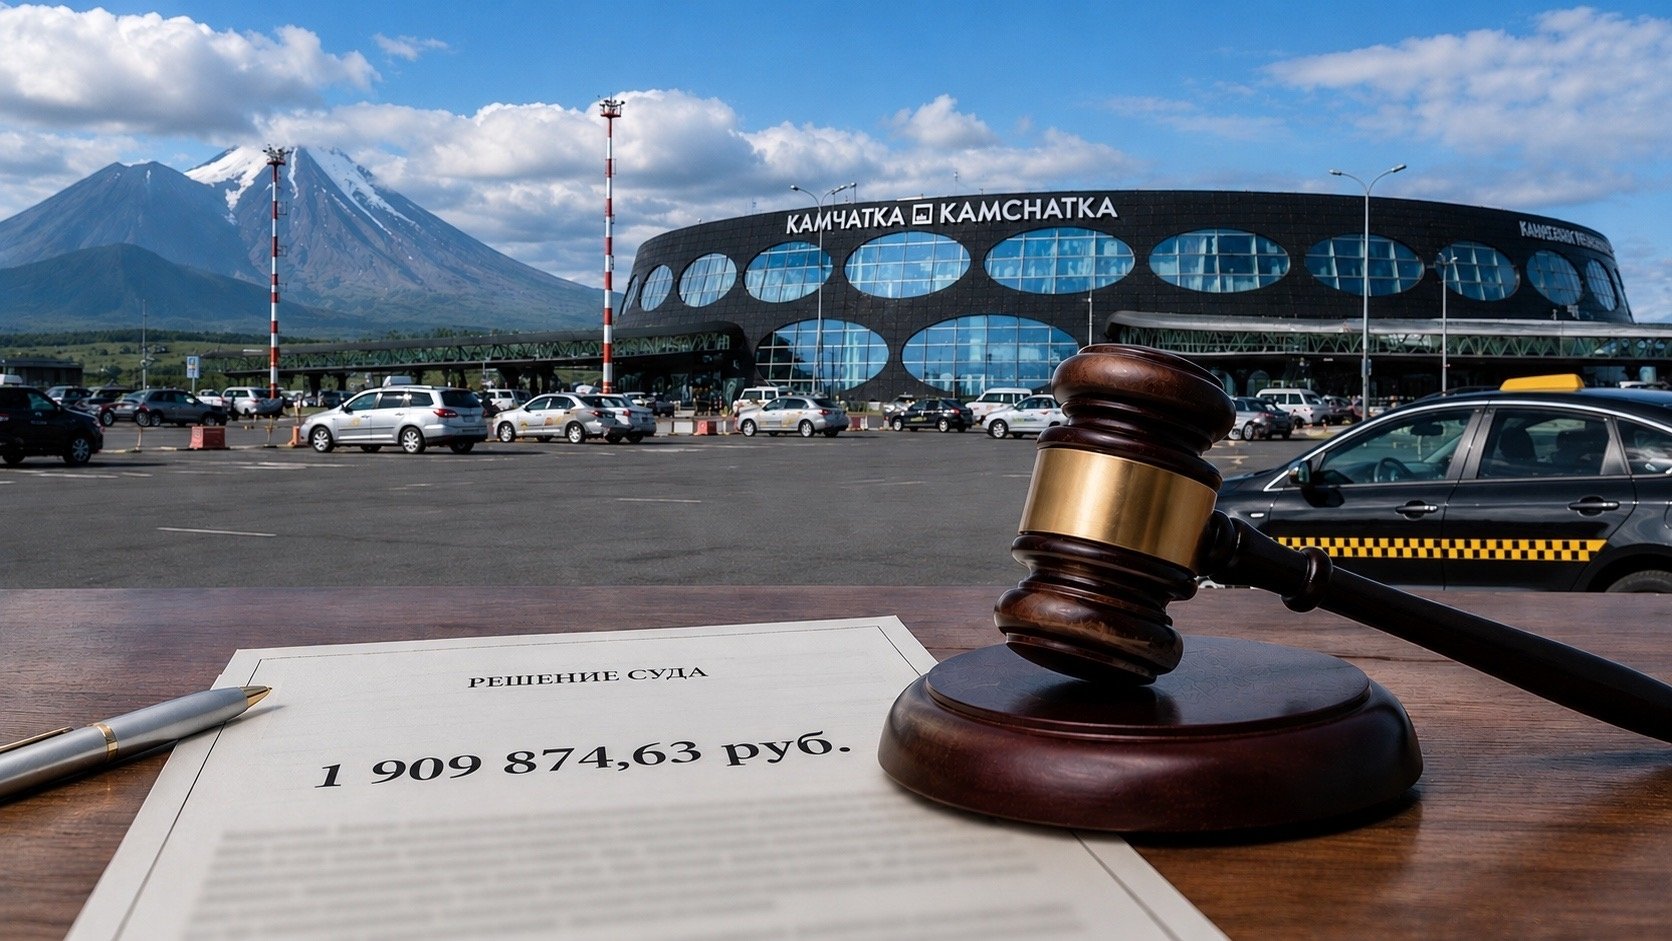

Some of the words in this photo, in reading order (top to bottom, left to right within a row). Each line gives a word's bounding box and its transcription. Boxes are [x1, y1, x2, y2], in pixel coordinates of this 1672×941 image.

[786, 205, 905, 235] КАМЧАТКА
[940, 196, 1118, 224] KAMCHATKA
[468, 669, 620, 689] РЕШЕНИЕ
[627, 666, 709, 682] СУДА
[314, 763, 342, 789] 1
[371, 754, 482, 785] 909
[503, 740, 702, 775] 874,63
[720, 730, 851, 767] руб.
